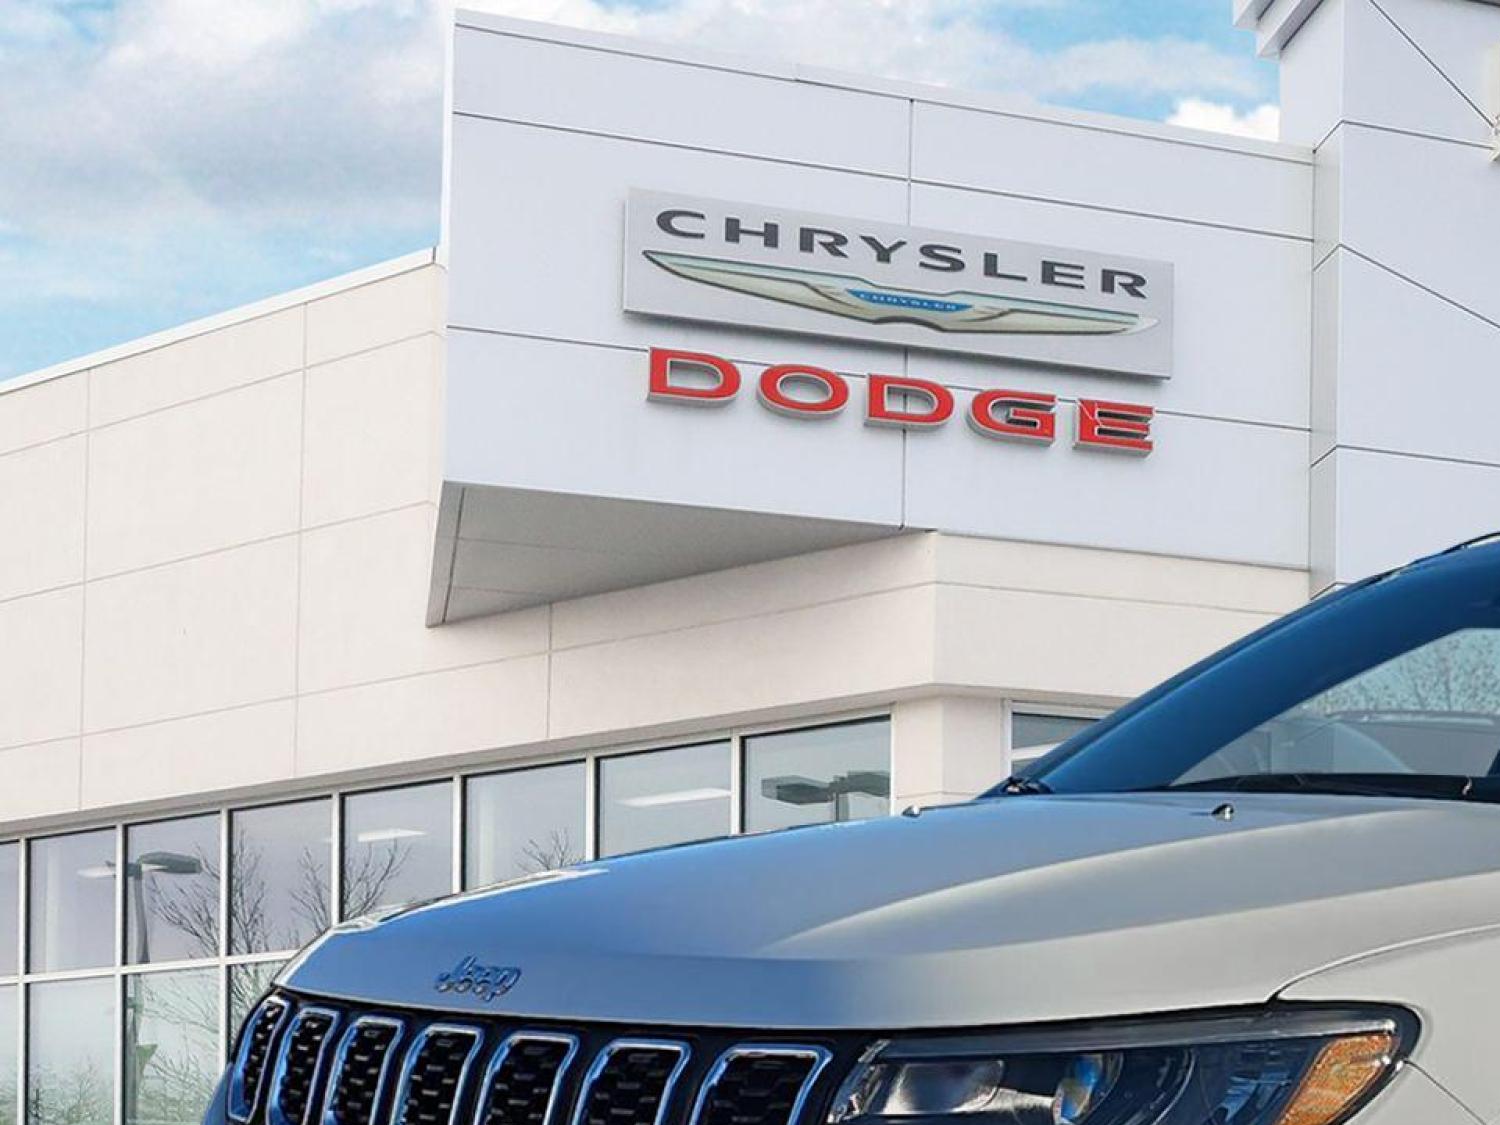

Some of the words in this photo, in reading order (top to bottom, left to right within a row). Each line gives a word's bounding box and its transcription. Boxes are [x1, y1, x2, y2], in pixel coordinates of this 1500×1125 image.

[655, 209, 1149, 298] CHRYSLER
[647, 346, 1155, 457] DODGE
[434, 956, 521, 1002] Jeep
